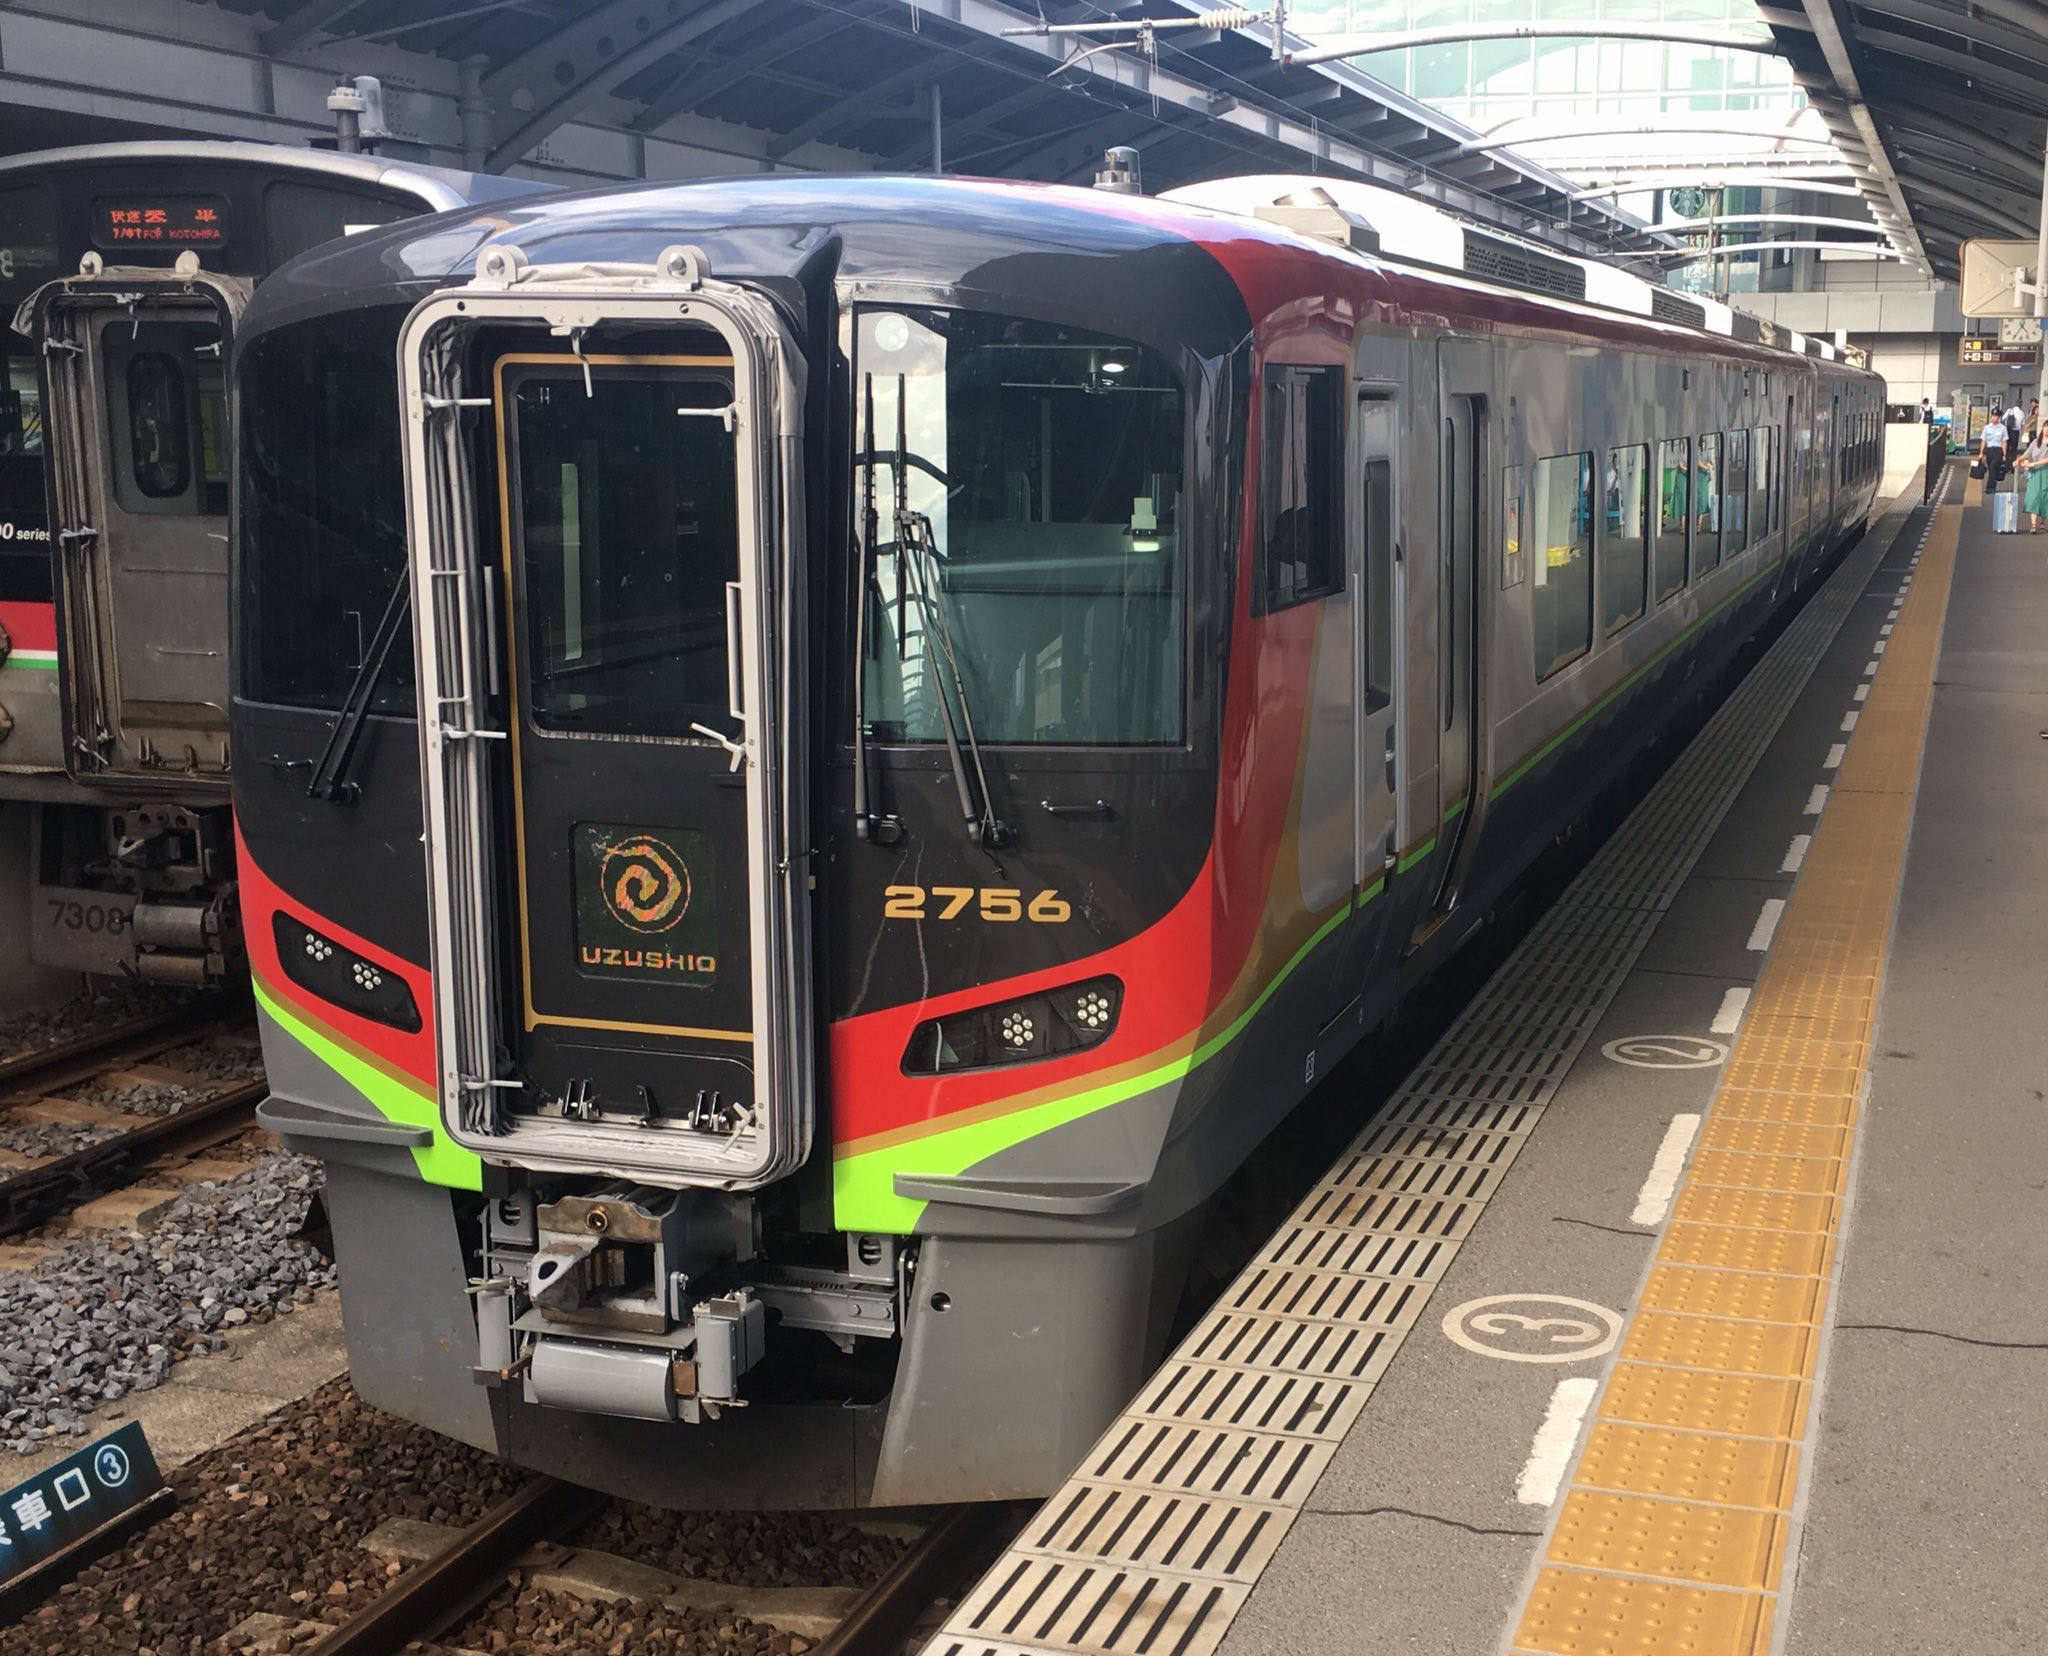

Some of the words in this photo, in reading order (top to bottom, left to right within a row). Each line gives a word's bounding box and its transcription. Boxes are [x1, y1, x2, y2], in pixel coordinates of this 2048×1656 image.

[169, 228, 221, 239] KOTOHIRA
[16, 528, 51, 541] series
[48, 898, 125, 936] 7308
[884, 885, 1071, 923] 2756
[581, 946, 716, 973] UZUSHIO
